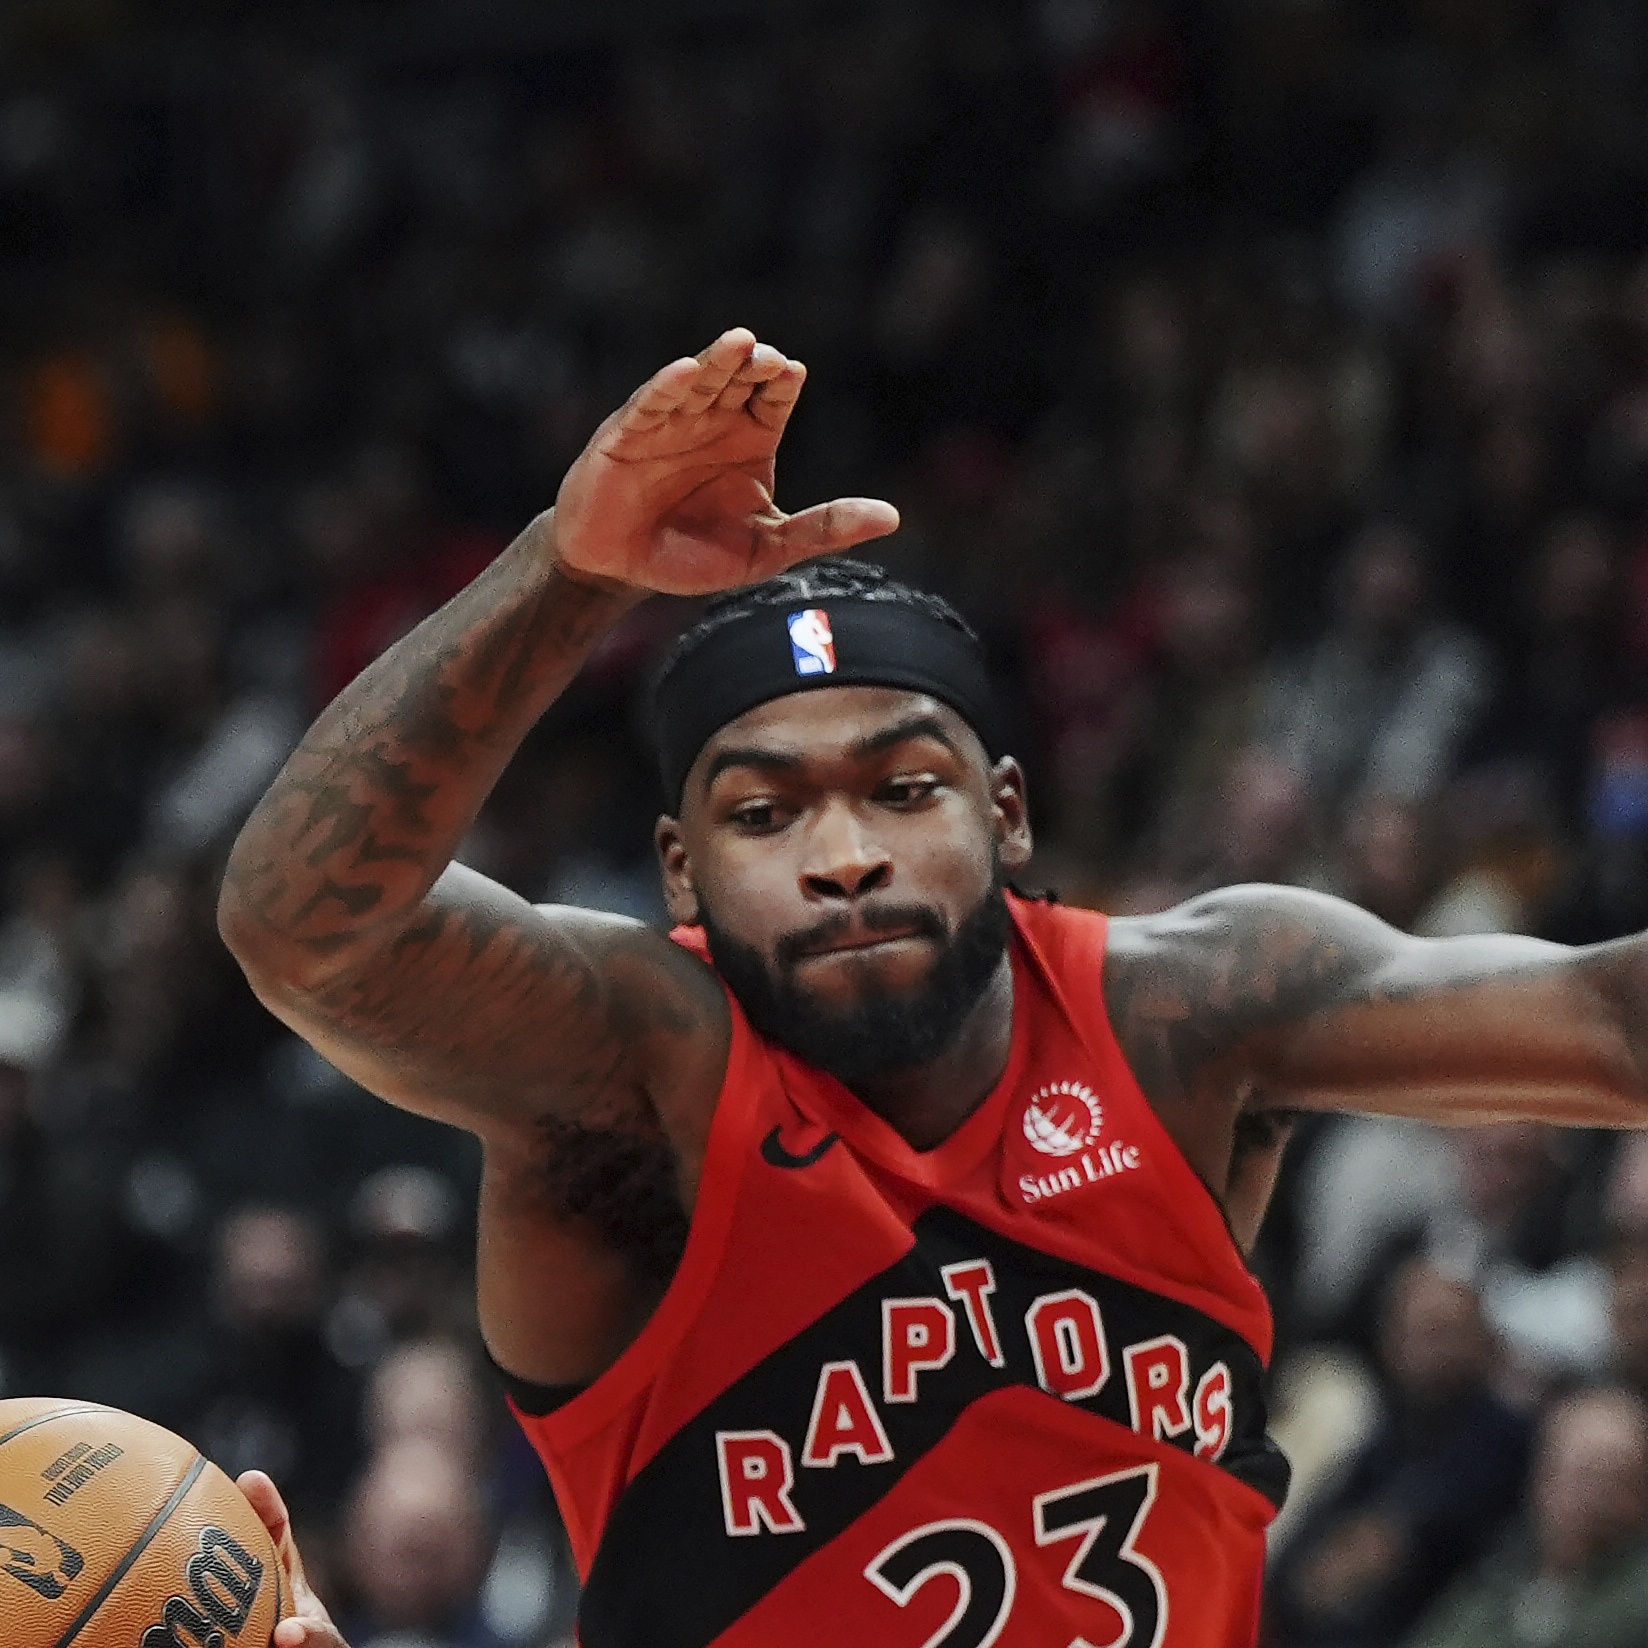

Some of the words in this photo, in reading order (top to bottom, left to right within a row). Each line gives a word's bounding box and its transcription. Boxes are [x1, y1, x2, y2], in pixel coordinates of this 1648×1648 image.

[1019, 1173, 1083, 1204] Sun
[1081, 1140, 1141, 1182] Life
[715, 1259, 1232, 1537] RAPTORS
